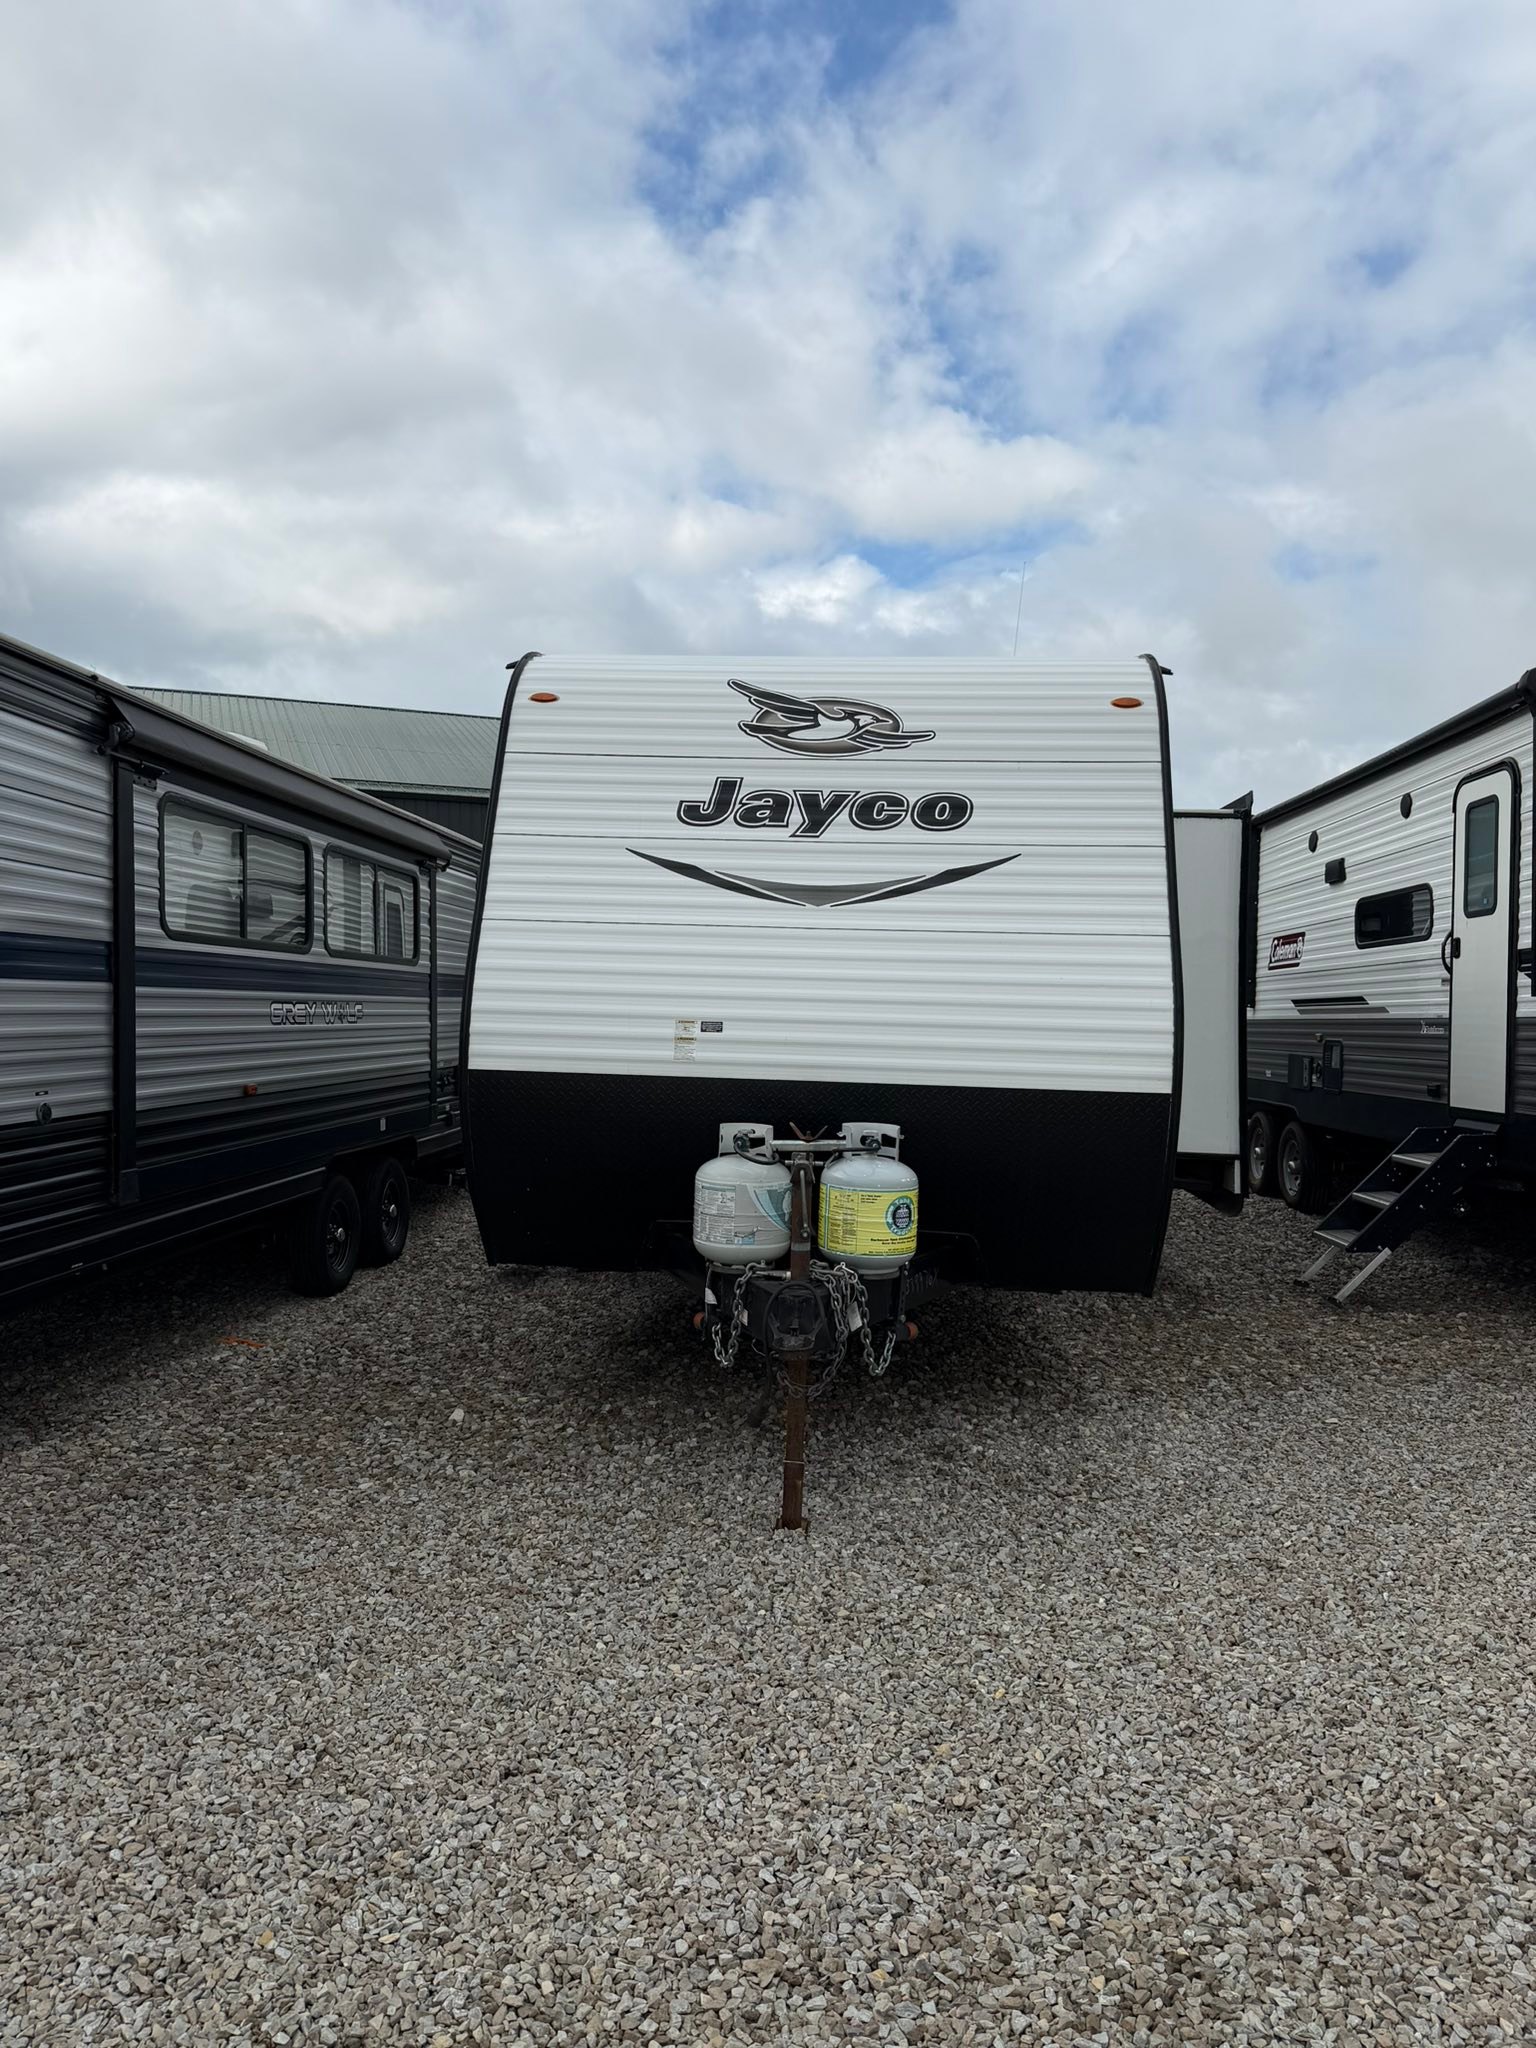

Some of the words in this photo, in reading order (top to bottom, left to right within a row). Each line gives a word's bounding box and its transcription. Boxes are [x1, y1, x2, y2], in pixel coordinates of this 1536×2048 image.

[676, 776, 974, 838] Jayco
[1272, 938, 1298, 962] Coleman
[270, 1000, 317, 1025] GREY
